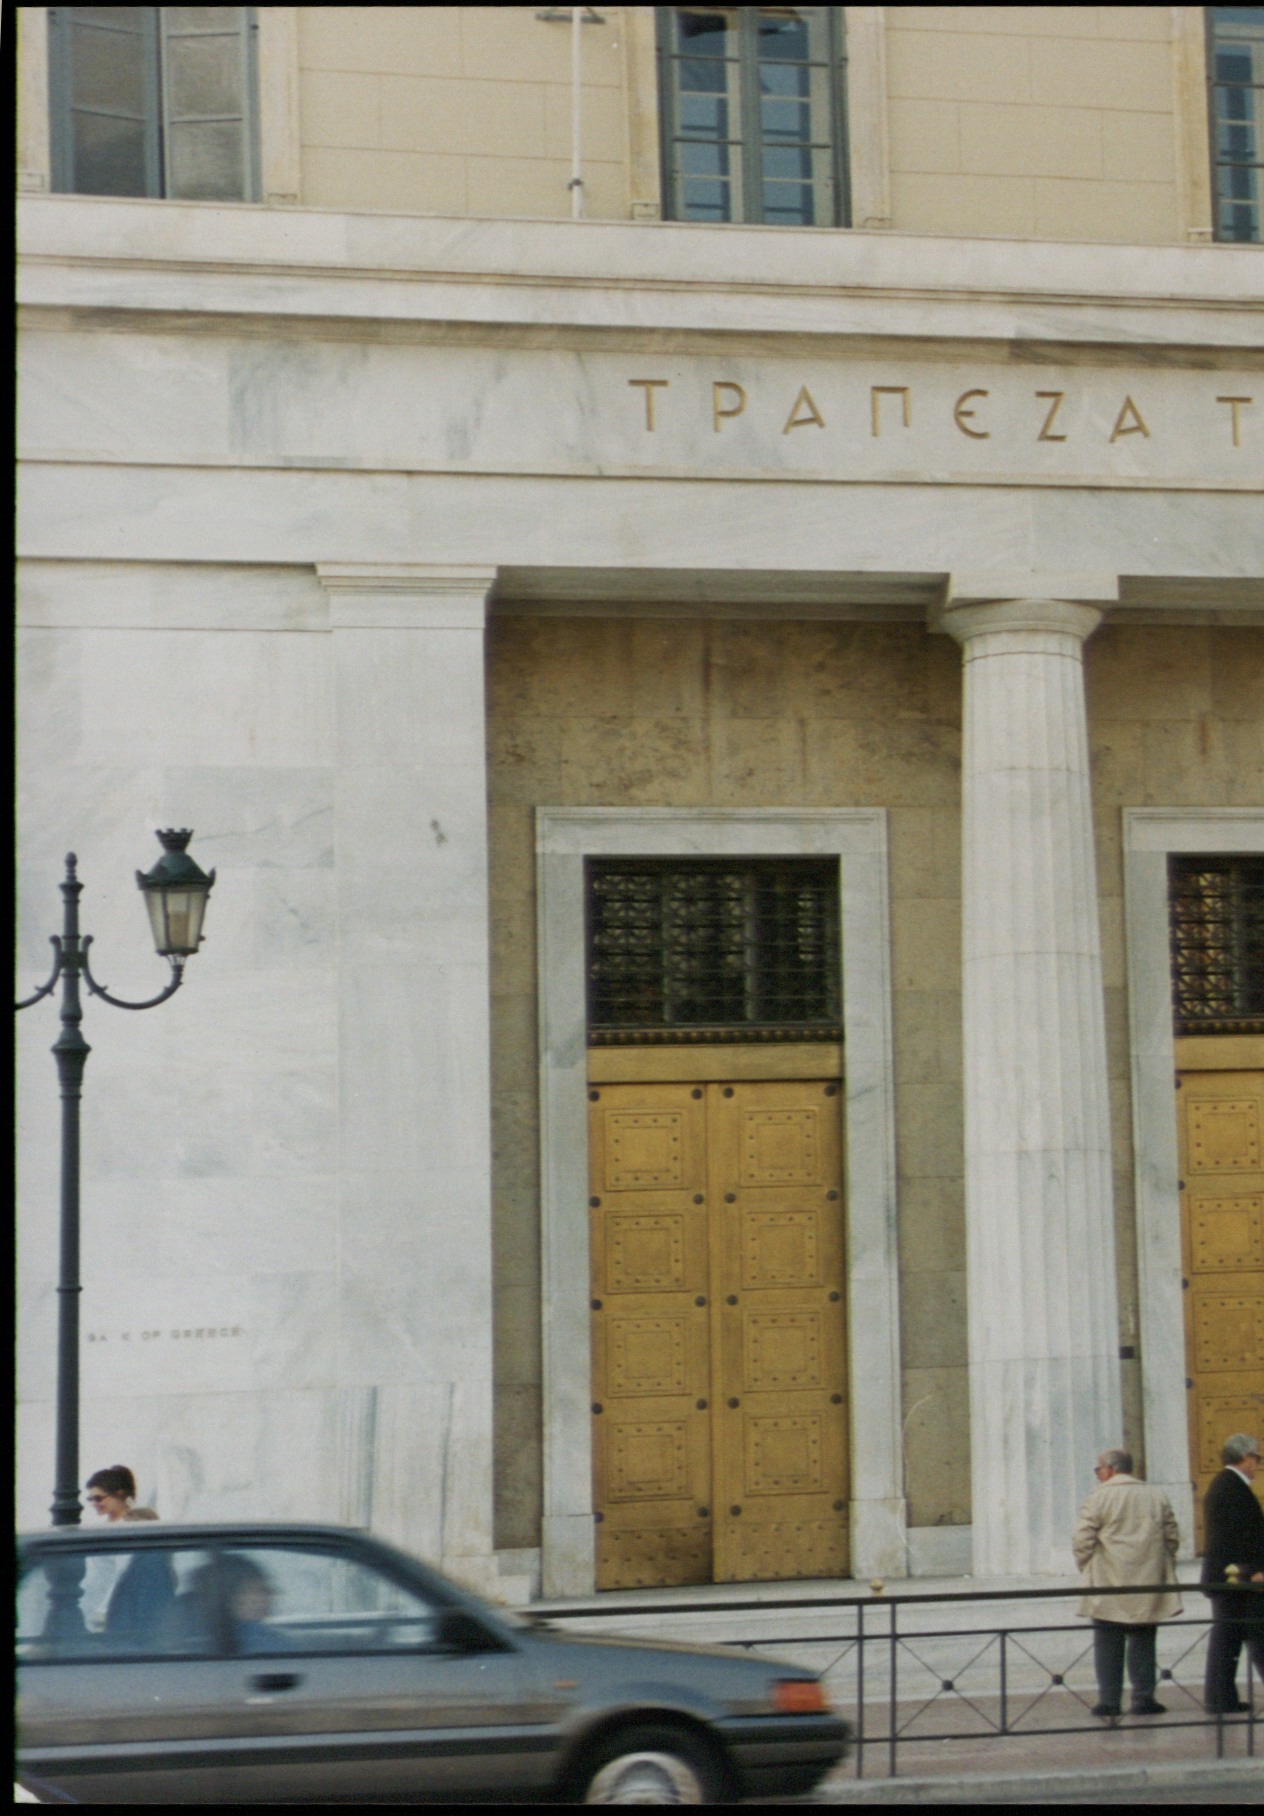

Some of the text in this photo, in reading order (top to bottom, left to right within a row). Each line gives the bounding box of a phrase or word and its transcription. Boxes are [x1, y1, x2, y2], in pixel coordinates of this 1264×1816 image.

[628, 379, 1150, 444] ΤΡΑΠΕΖΑ
[87, 1326, 241, 1343] BAK OF GREECE
